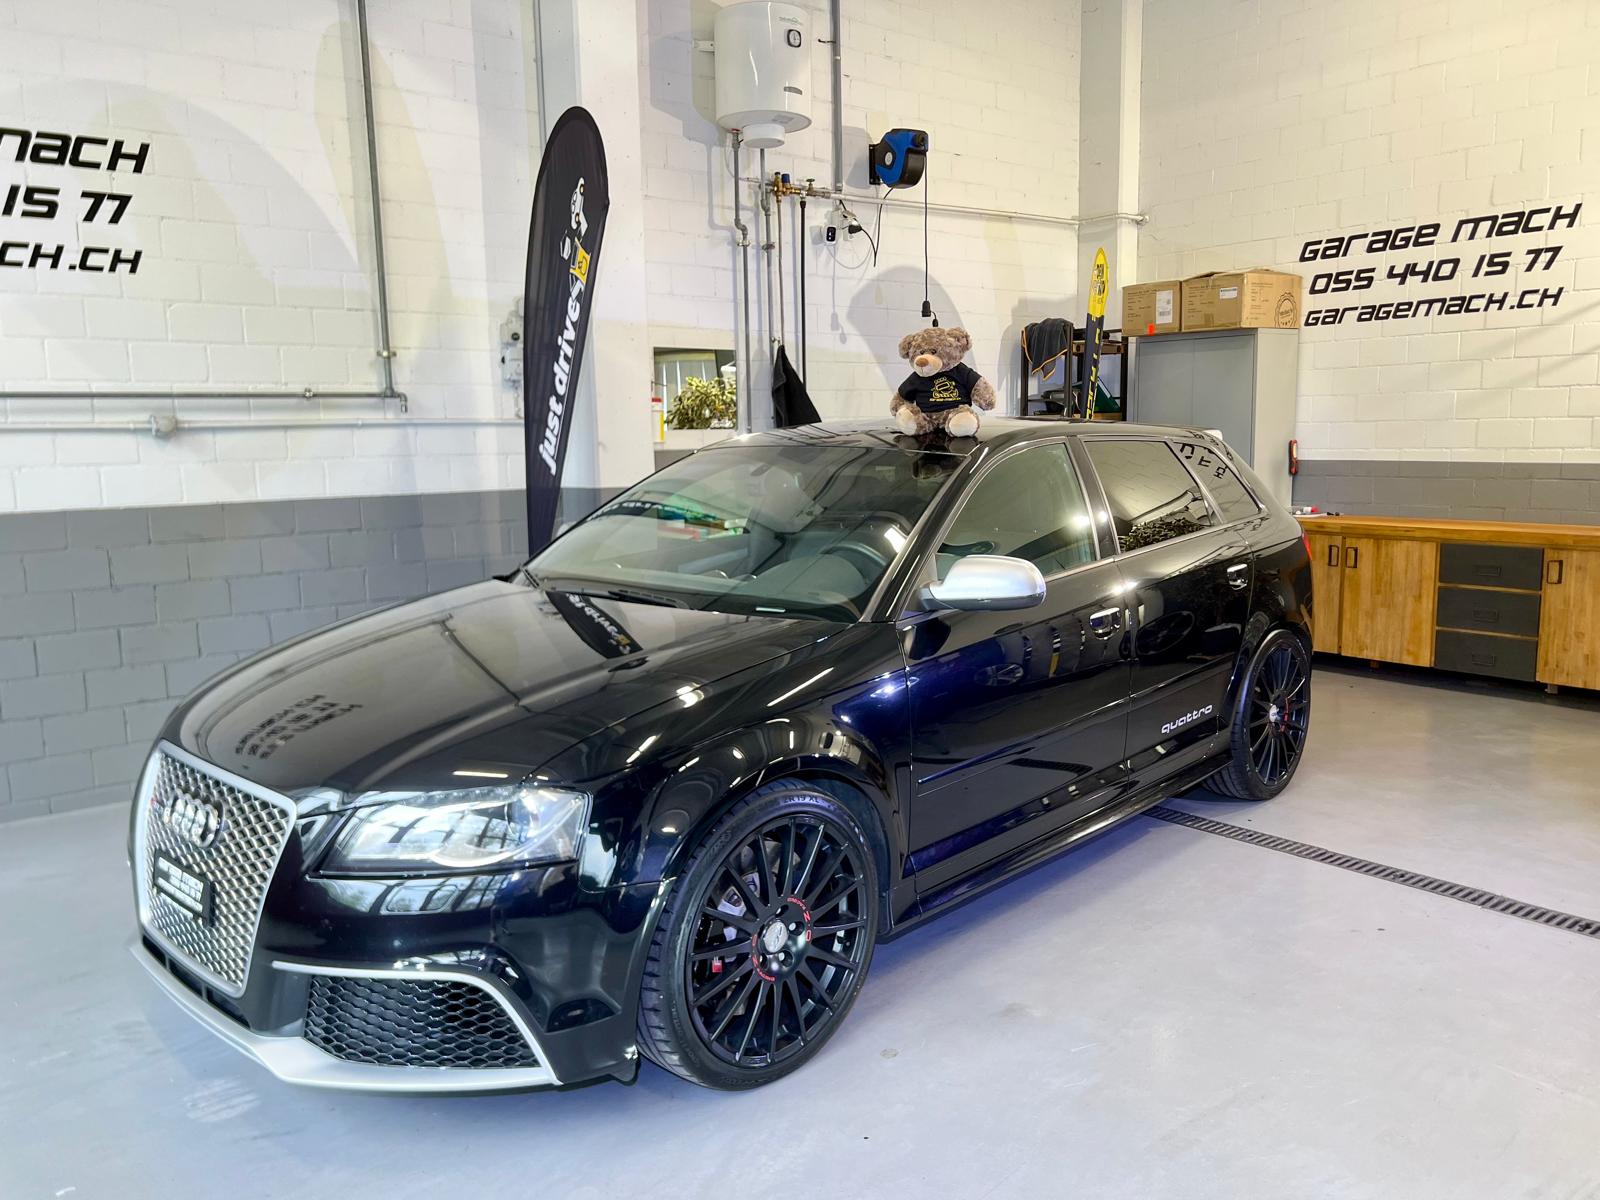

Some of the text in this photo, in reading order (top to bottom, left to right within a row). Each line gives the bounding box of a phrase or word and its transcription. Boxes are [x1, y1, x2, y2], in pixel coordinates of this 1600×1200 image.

[2, 184, 133, 224] 15 77
[1308, 245, 1564, 295] 055 440 15 77
[539, 396, 563, 476] just
[1161, 704, 1213, 734] quattro
